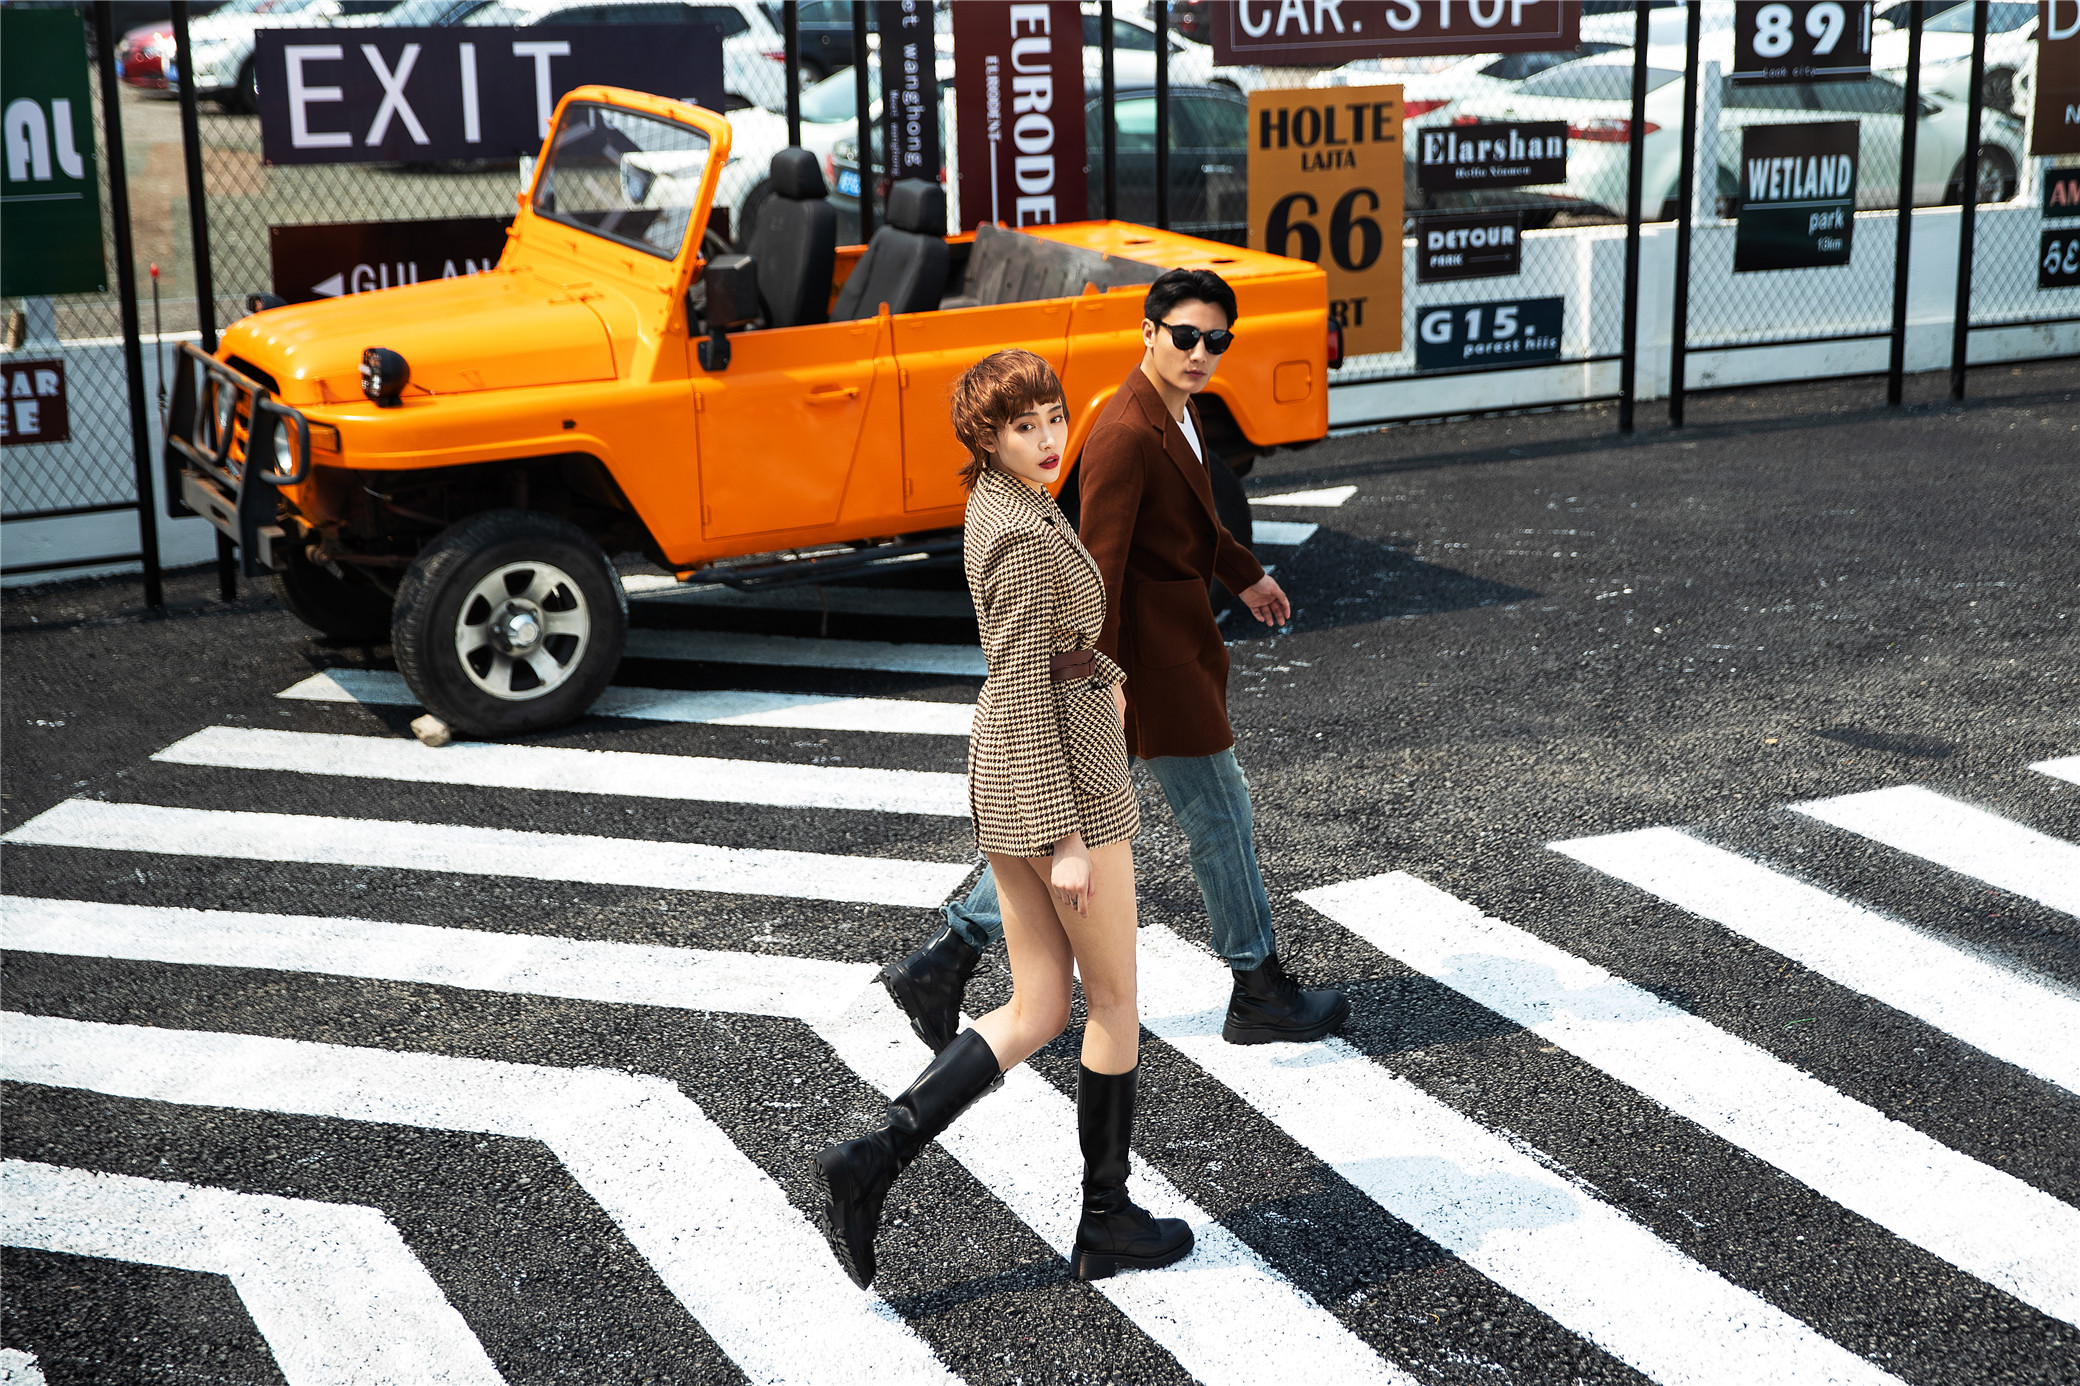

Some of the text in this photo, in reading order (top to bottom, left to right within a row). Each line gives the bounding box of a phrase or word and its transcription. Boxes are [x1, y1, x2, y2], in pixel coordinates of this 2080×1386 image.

[1238, 0, 1362, 37] CAR.
[1752, 2, 1847, 58] 89
[284, 41, 571, 148] EXIT
[902, 43, 926, 167] wanghong
[985, 55, 1001, 141] EURODENT
[4, 97, 85, 182] AL
[1259, 101, 1396, 150] HOLTE
[1422, 128, 1564, 165] Elarshan
[1301, 149, 1357, 172] LAJTA
[1748, 154, 1853, 201] WETLAND
[1264, 187, 1382, 273] 66
[1427, 225, 1516, 250] DETOUR
[1808, 207, 1846, 236] park
